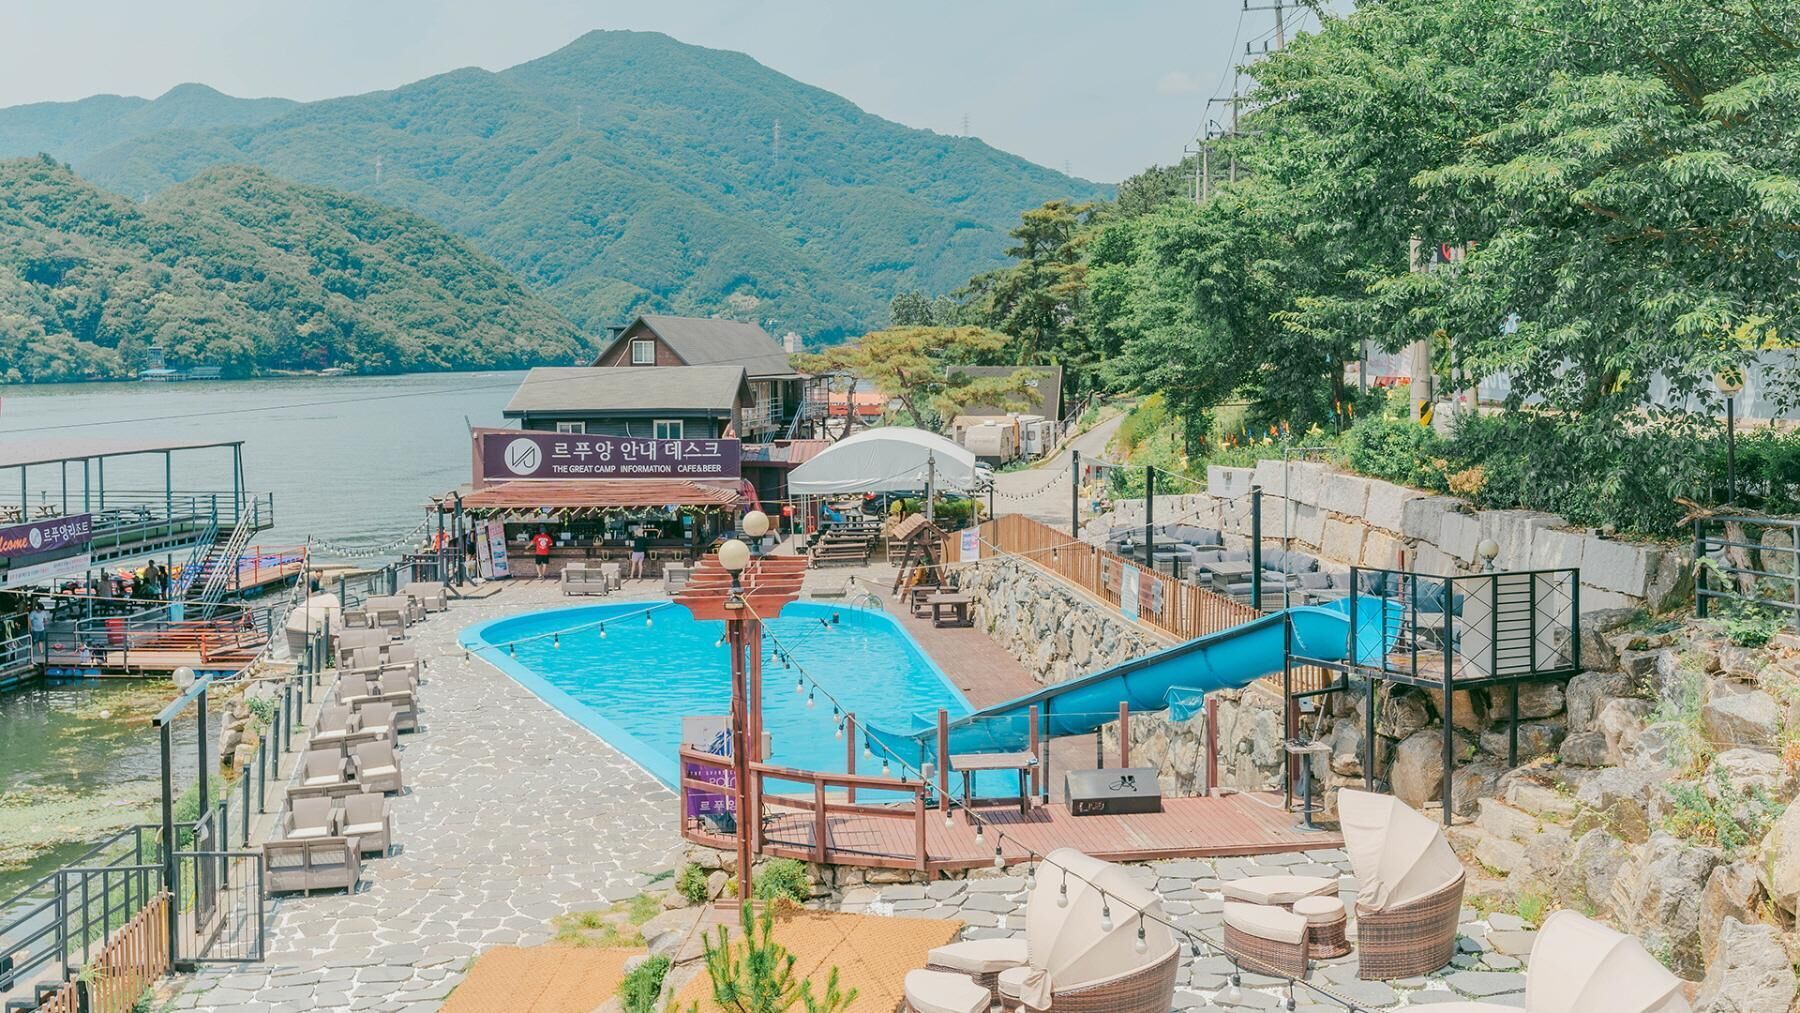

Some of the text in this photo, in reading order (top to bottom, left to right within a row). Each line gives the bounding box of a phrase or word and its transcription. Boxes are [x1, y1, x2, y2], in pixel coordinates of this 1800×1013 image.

[552, 441, 722, 462] 르푸앙 안내 데스크
[552, 464, 722, 473] THE GREAT CAMP INFORMATION CAFE&BEER
